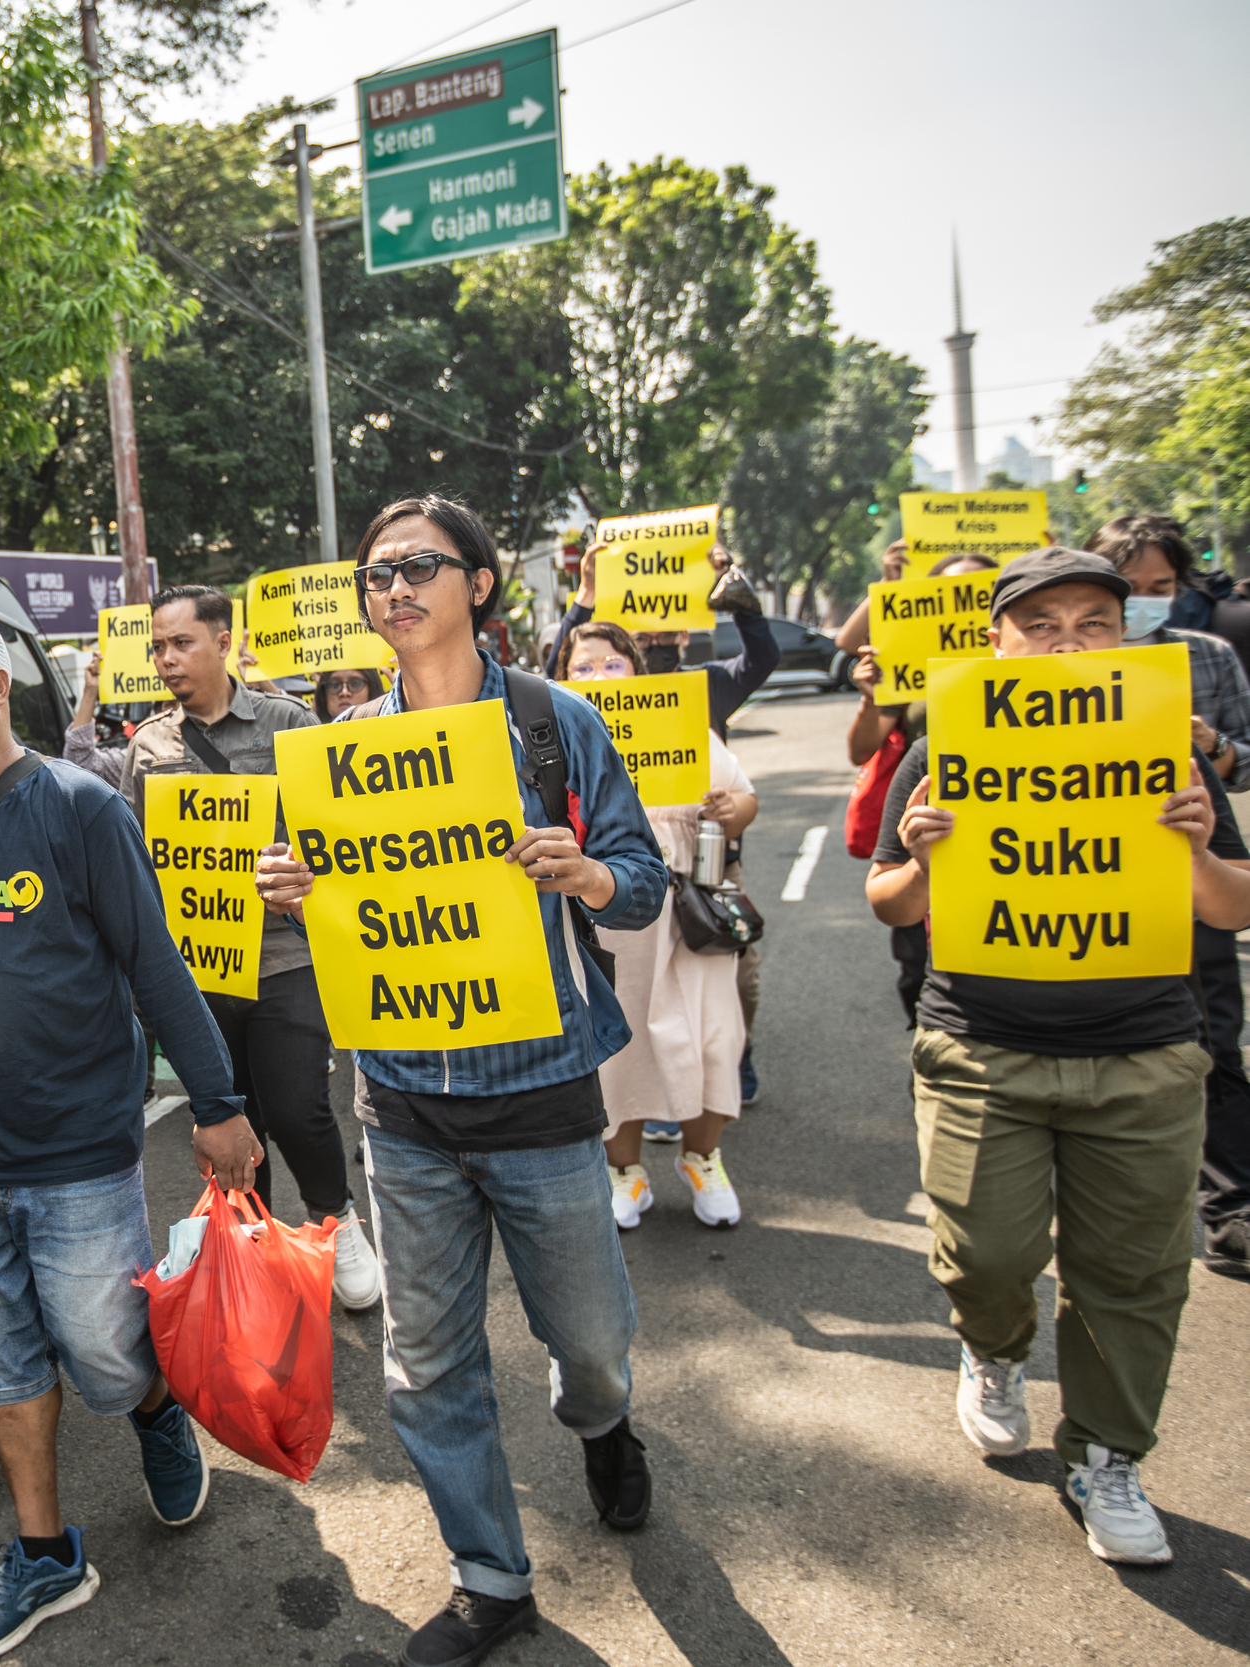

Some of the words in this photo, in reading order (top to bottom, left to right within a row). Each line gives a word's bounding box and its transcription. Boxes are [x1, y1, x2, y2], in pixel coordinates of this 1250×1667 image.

[369, 88, 413, 121] Lap.
[415, 66, 501, 109] Banteng
[372, 122, 437, 157] Senen
[428, 158, 517, 204] Harmoni
[431, 205, 491, 241] Gajah
[496, 195, 551, 229] Mada
[923, 501, 960, 515] Kami
[965, 500, 1029, 514] Melawan
[603, 521, 710, 543] Bersama
[955, 519, 997, 534] Krisis
[624, 551, 684, 576] Suku
[914, 540, 1040, 555] Keanekaragaman
[261, 579, 296, 601] Kami
[301, 574, 354, 593] Melaw
[293, 598, 338, 618] Krisis
[621, 590, 687, 619] Awyu
[881, 588, 944, 621] Kami
[108, 614, 150, 637] Kami
[255, 620, 377, 649] Keanekaragam
[939, 622, 989, 651] Kris
[293, 643, 344, 666] Hayati
[113, 671, 168, 694] Kema
[586, 690, 678, 713] Melawan
[984, 671, 1123, 728] Kami
[326, 731, 454, 799] Kami
[938, 754, 1176, 802] Bersama
[179, 789, 250, 822] Kami
[152, 838, 261, 873] Bersam
[297, 819, 514, 877] Bersama
[989, 827, 1121, 876] Suku
[180, 886, 244, 923] Suku
[358, 895, 480, 950] Suku
[983, 900, 1129, 960] Awyu
[180, 936, 243, 980] Awyu
[371, 974, 501, 1030] Awyu
